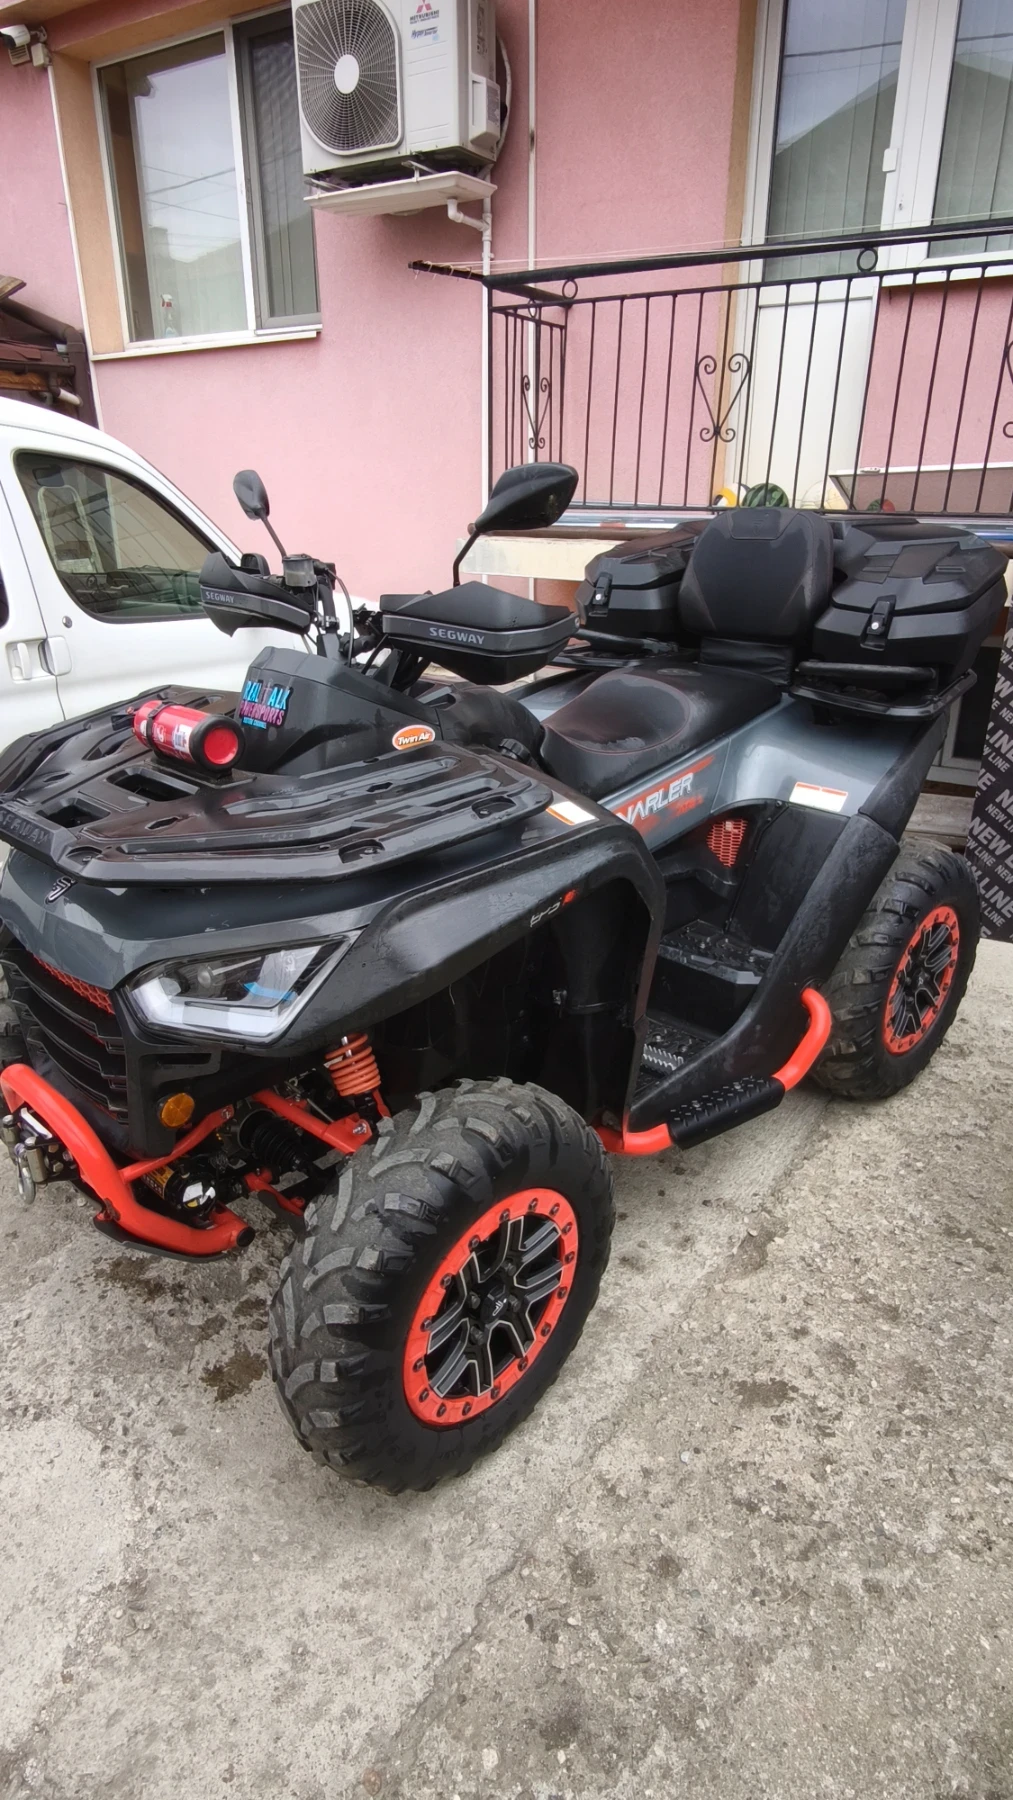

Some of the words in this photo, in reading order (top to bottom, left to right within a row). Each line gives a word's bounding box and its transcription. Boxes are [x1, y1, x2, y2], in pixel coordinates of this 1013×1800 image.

[205, 591, 235, 604] SEGWAY
[429, 627, 485, 645] SEGWAY
[398, 735, 418, 746] Twin
[419, 731, 431, 741] Air
[988, 752, 1011, 773] LINE
[985, 803, 1008, 823] NEW
[968, 816, 1012, 856] NEW
[974, 846, 996, 867] LINE
[983, 906, 1006, 927] LINE
